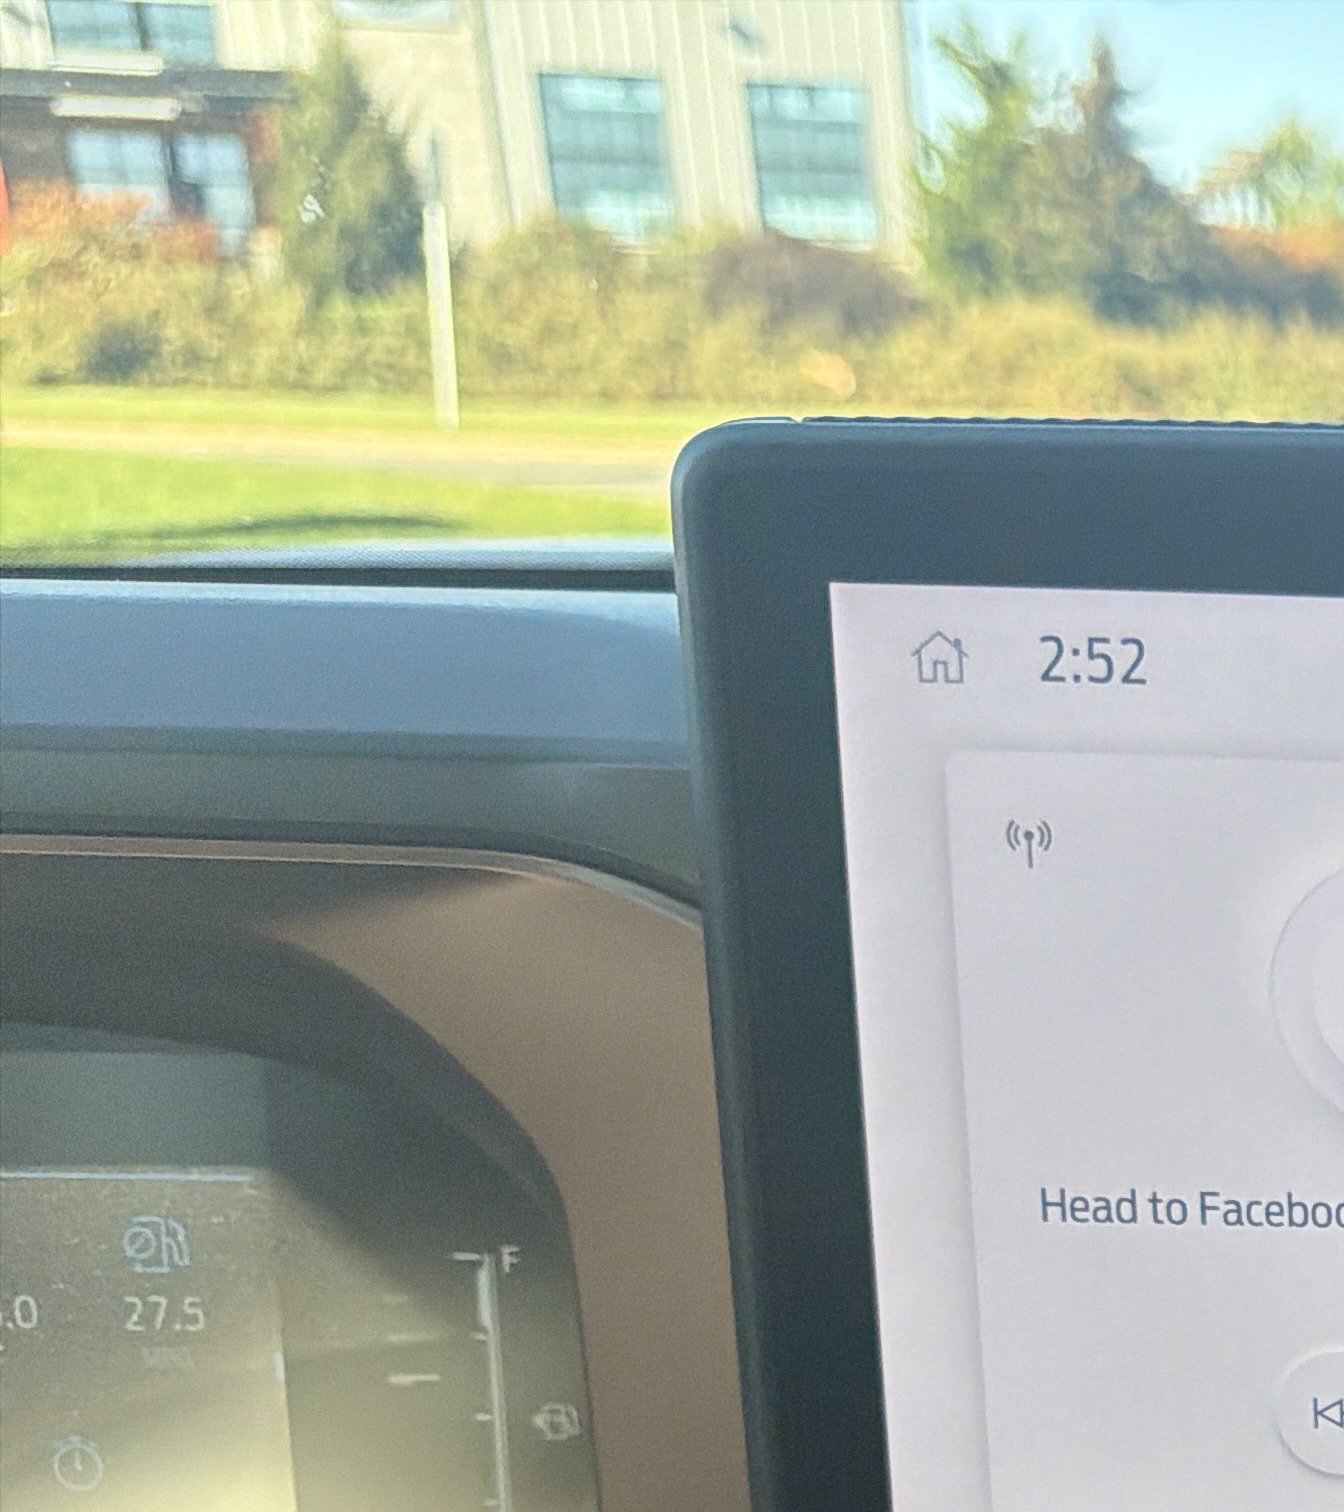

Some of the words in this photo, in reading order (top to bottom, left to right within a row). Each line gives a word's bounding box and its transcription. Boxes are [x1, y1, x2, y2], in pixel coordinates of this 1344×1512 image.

[1038, 634, 1148, 685] 2:52
[1040, 1187, 1138, 1224] Head
[1147, 1191, 1188, 1226] to
[124, 1294, 205, 1333] 27.5
